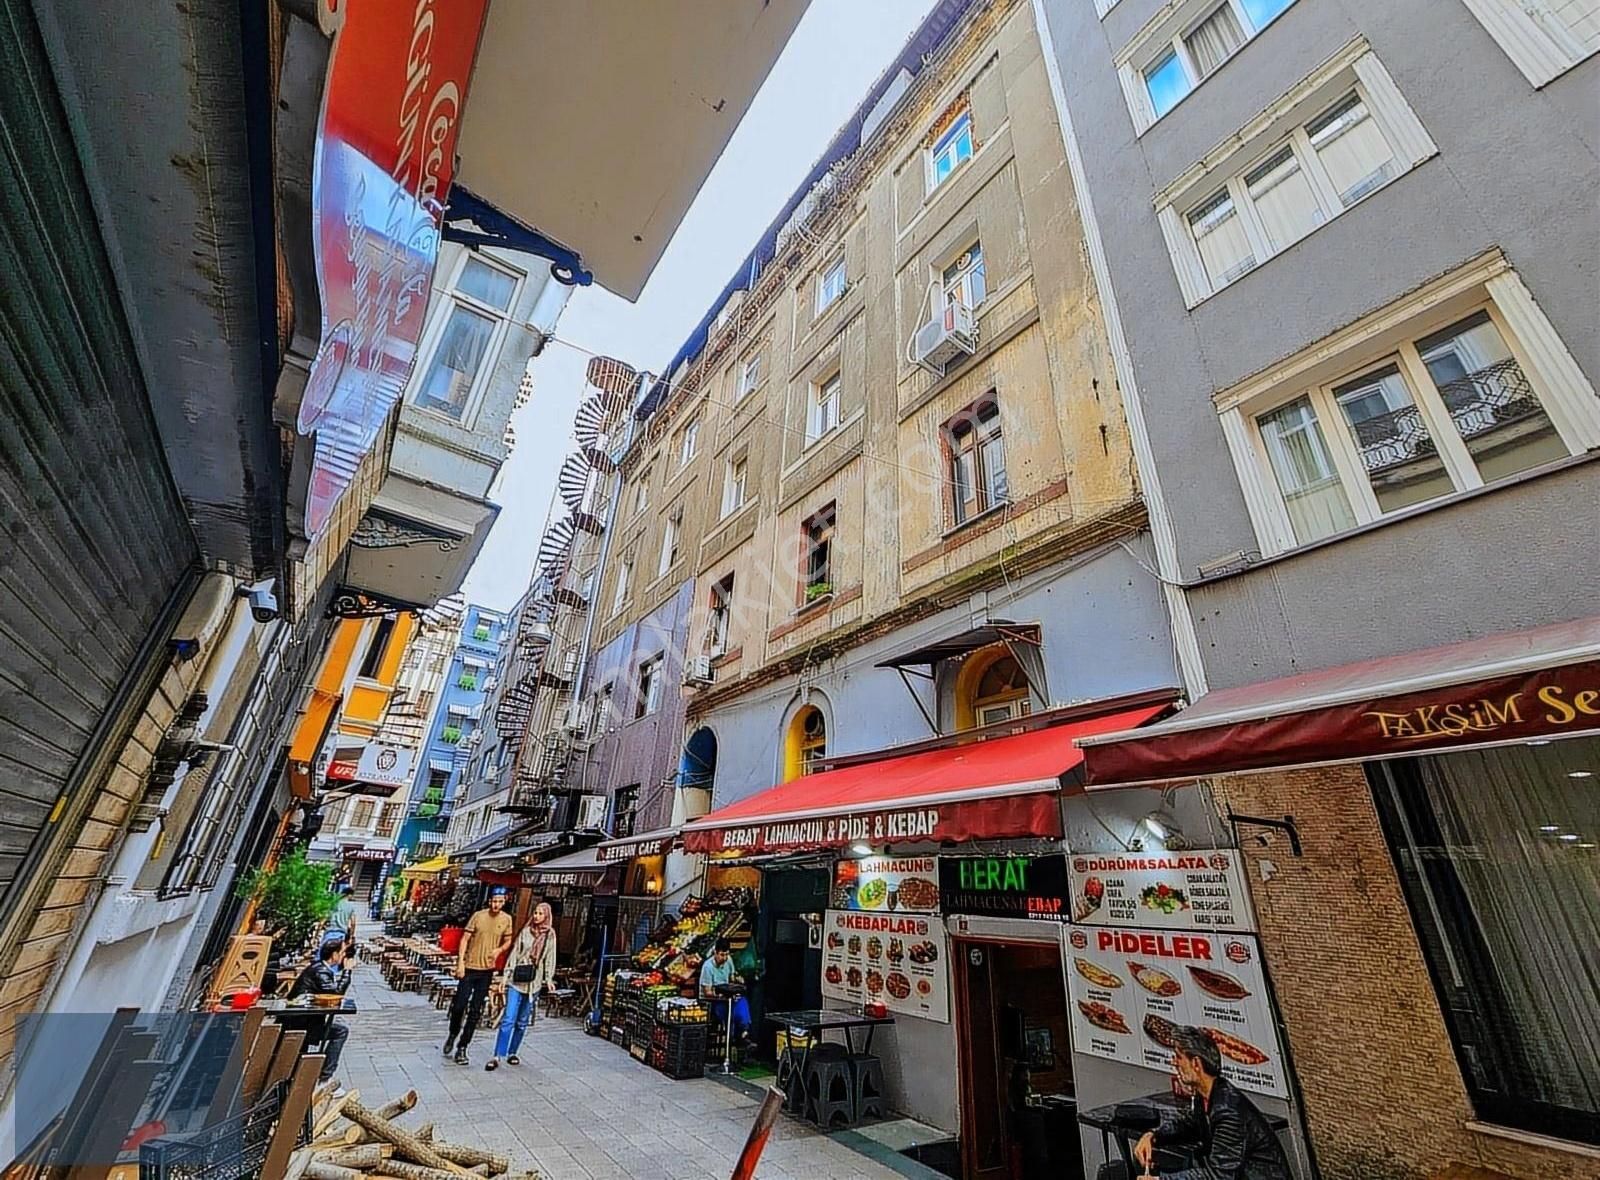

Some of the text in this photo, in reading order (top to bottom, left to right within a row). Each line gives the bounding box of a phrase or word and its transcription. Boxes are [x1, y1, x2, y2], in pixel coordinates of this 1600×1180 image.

[723, 810, 939, 848] BERAT LAHMACUN & PİDE & KEBAP
[638, 840, 661, 856] CAFE
[859, 859, 923, 873] LAHMACUN
[960, 858, 1029, 891] BERAT
[846, 915, 916, 935] KEBAPLAR
